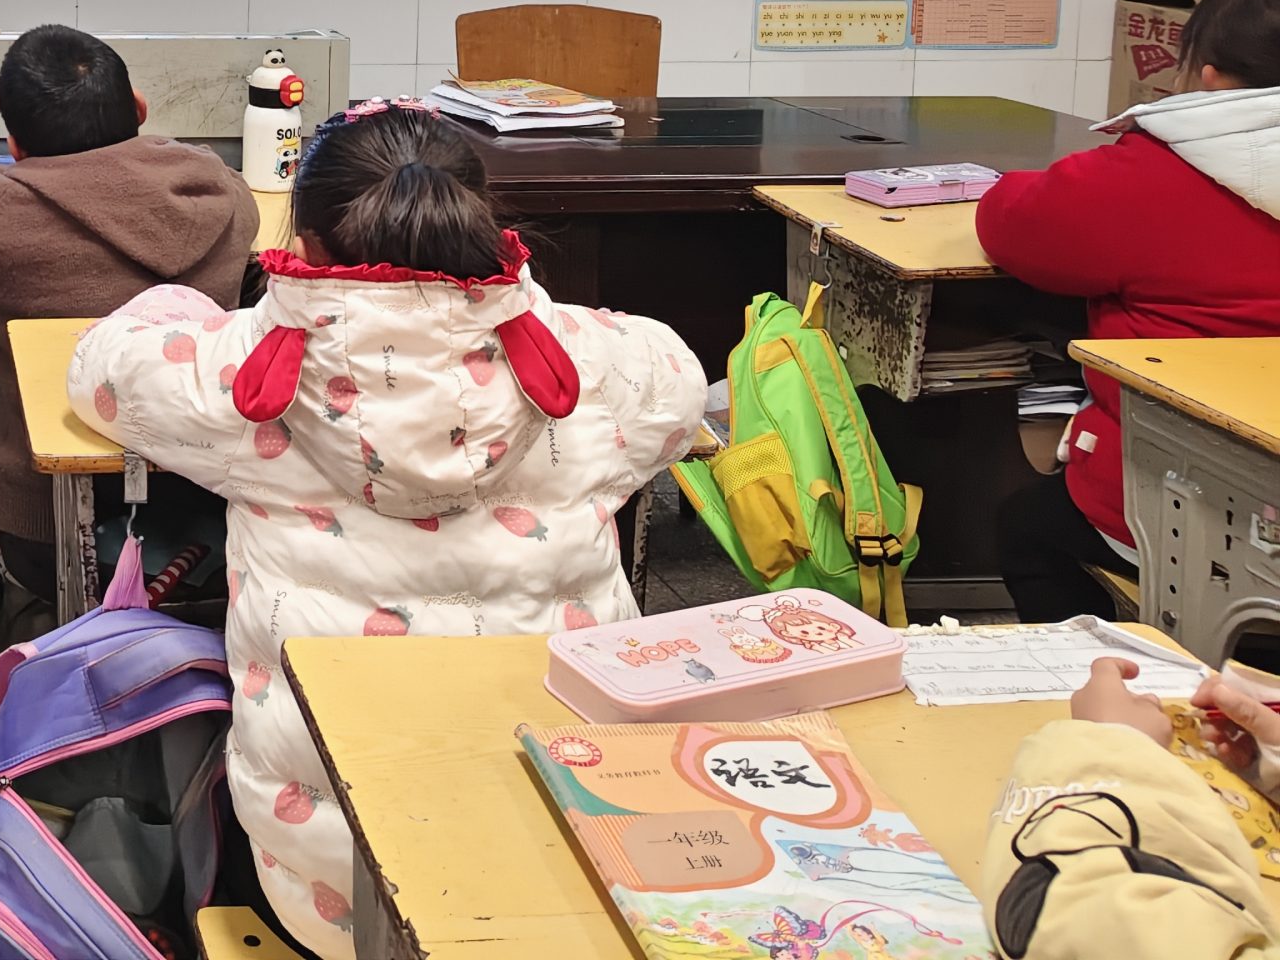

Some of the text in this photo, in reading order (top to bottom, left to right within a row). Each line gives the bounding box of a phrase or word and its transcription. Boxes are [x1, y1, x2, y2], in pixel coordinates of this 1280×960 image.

[382, 344, 398, 391] Smile
[547, 417, 560, 468] Smile
[270, 590, 287, 637] Smile
[616, 638, 702, 667] HOPE
[709, 757, 832, 789] 语文
[647, 828, 730, 848] 一年级
[685, 855, 723, 870] 上册
